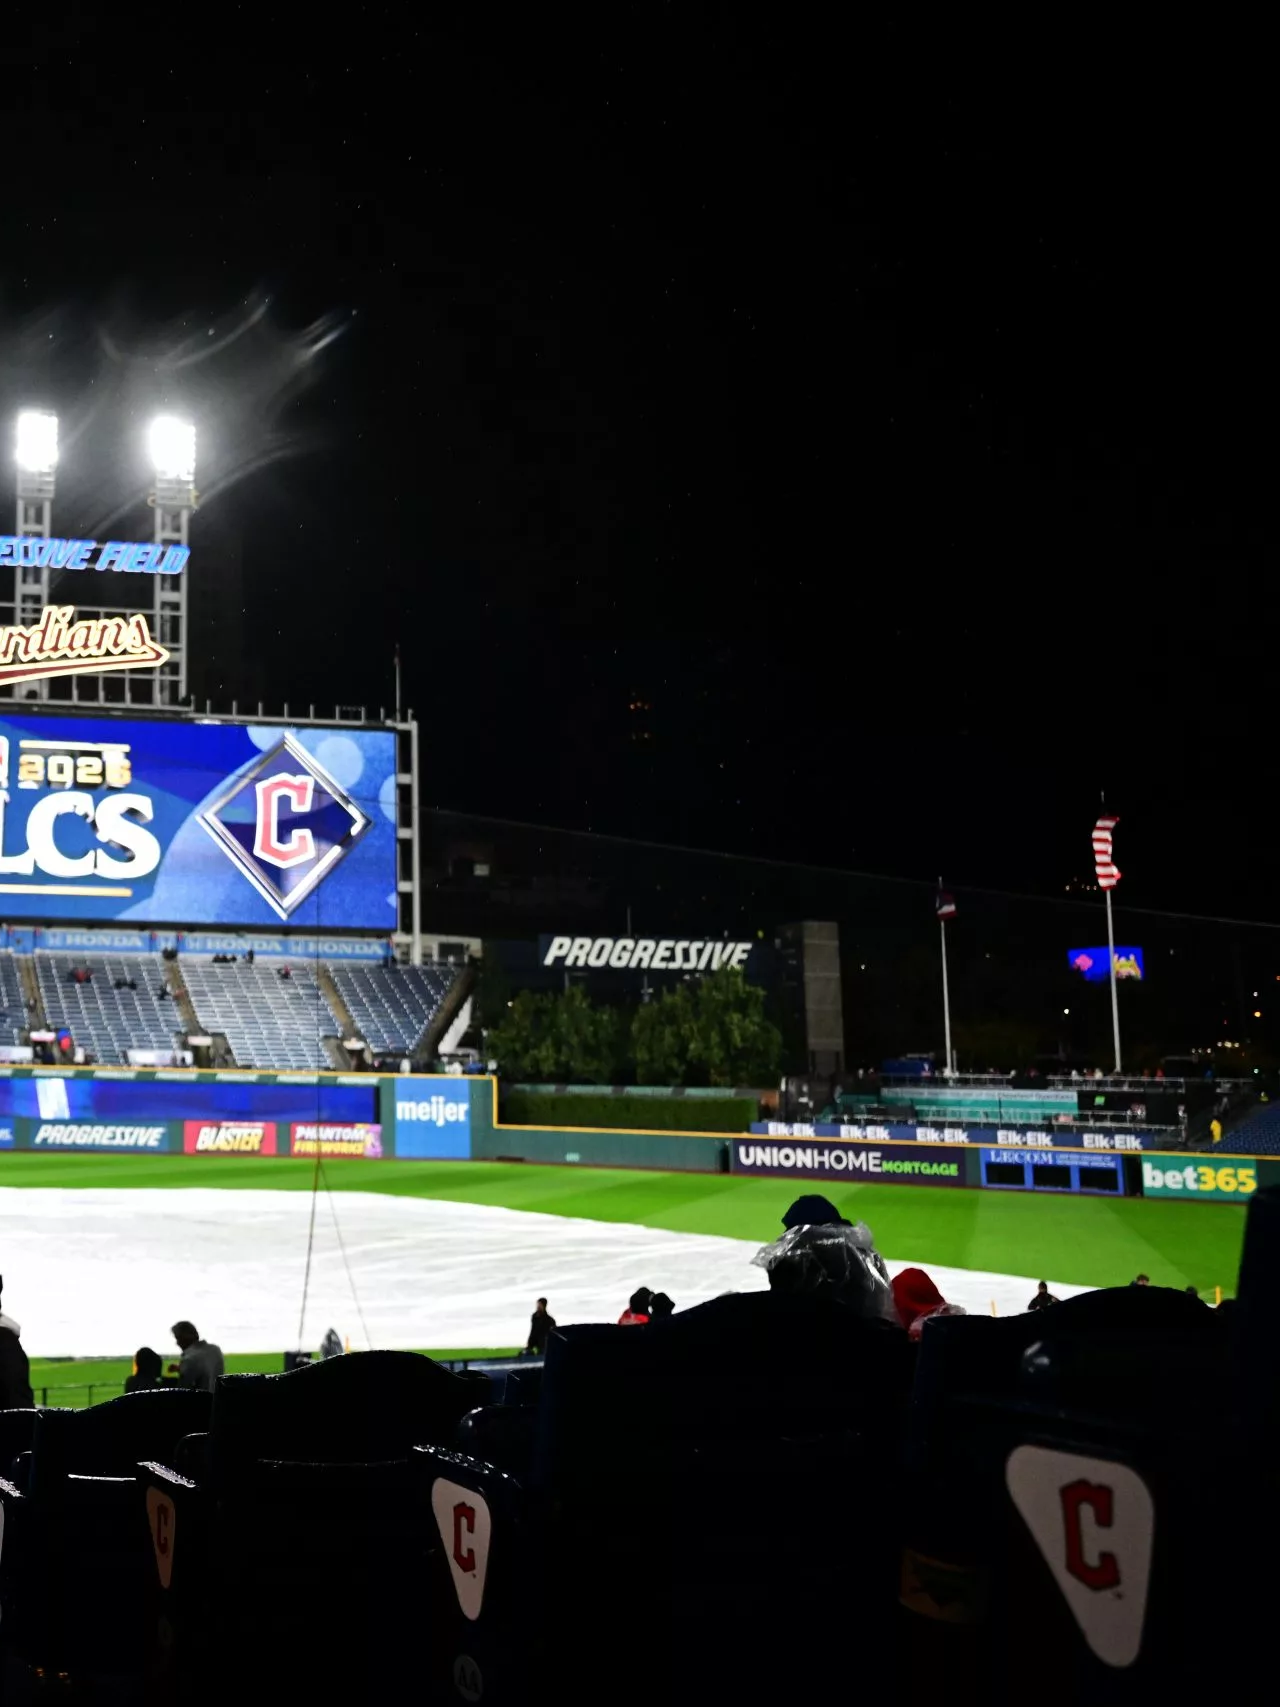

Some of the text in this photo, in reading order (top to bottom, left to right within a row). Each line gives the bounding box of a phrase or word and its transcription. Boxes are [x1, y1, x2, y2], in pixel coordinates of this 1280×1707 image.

[95, 541, 191, 574] FIELD
[65, 934, 142, 948] HONDA
[206, 936, 283, 953] HONDA
[308, 940, 383, 955] HONDA
[543, 936, 753, 971] PROGRESSIVE
[396, 1096, 470, 1127] meijer
[34, 1124, 167, 1147] PROGRESSIVE
[195, 1126, 264, 1152] BLASTER
[295, 1125, 366, 1141] PHANTOM
[881, 1160, 959, 1177] MORTGAGE
[990, 1149, 1054, 1165] LECOM
[1142, 1162, 1257, 1193] bet365
[453, 1501, 476, 1573] C
[1060, 1478, 1121, 1591] C
